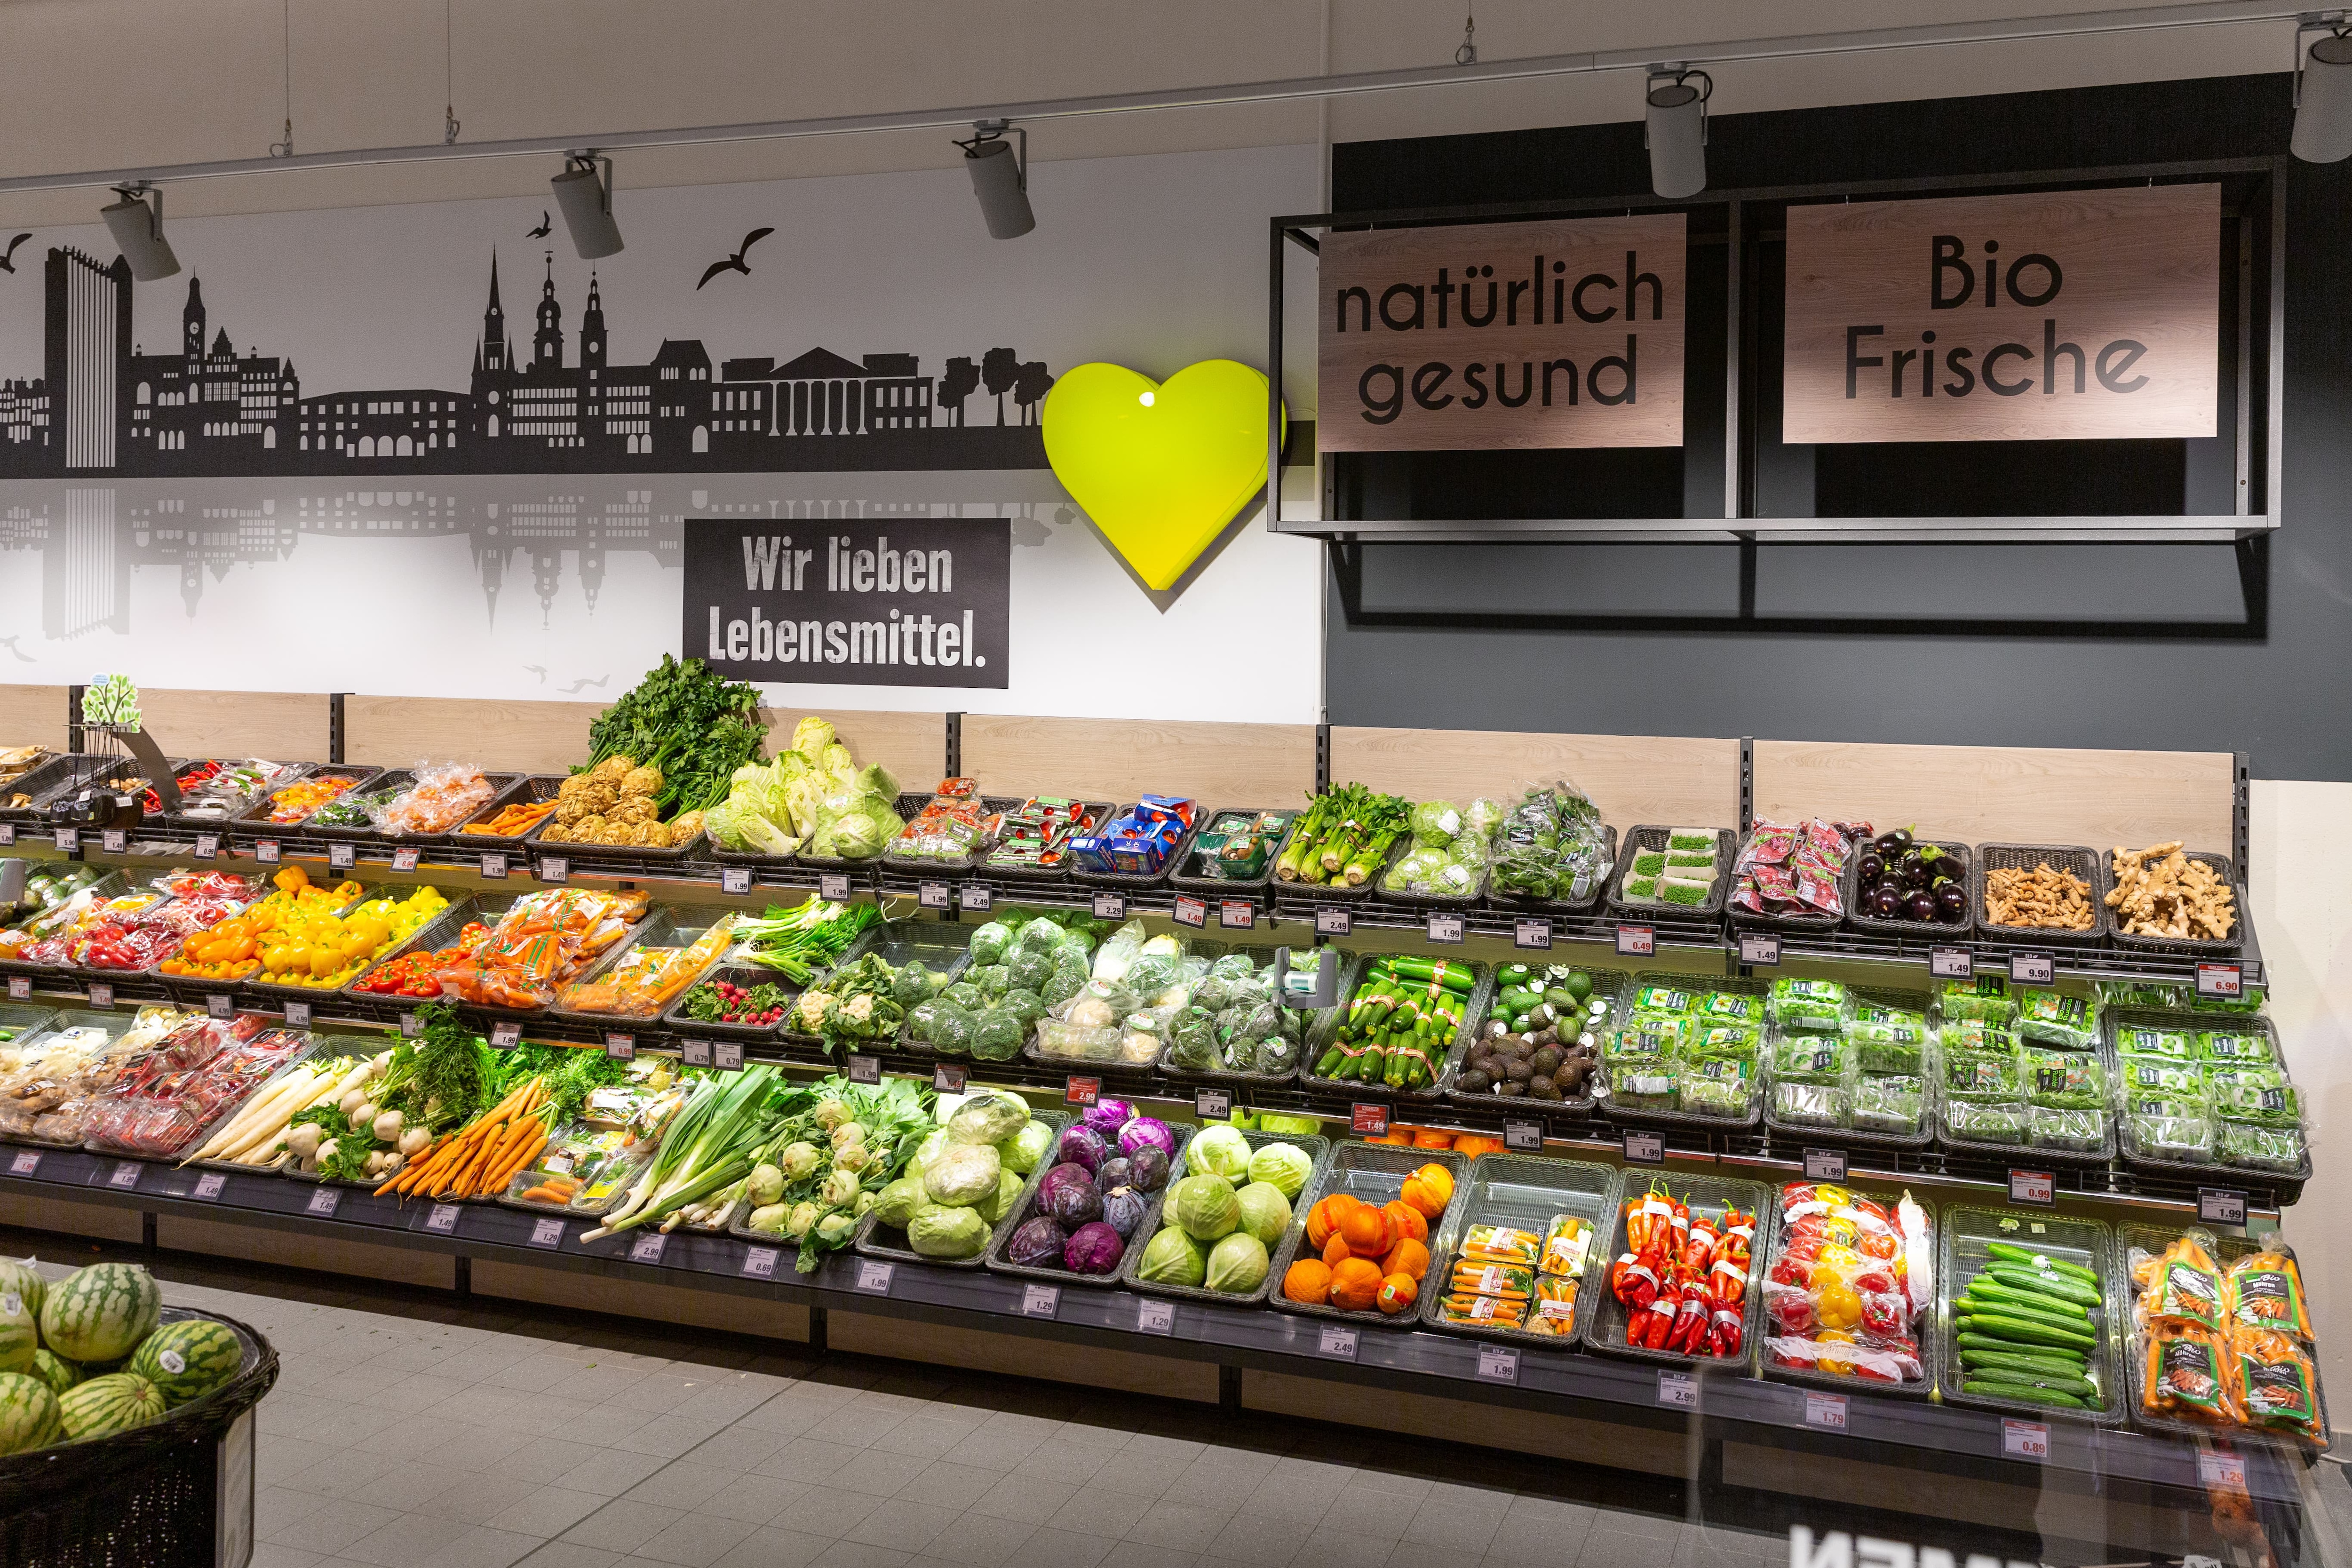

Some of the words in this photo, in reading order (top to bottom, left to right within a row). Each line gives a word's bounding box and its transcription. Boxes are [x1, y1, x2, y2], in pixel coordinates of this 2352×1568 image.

[1931, 235, 2062, 310] Bio
[1337, 251, 1662, 332] natürlich
[1846, 319, 2150, 399] Frische
[1359, 334, 1637, 425] gesund
[742, 536, 812, 591] Wir
[828, 536, 952, 593] lieben
[709, 606, 986, 668] Lebensmittel.
[1187, 913, 1202, 922] 1.49
[1633, 941, 1651, 950] 0.49
[1757, 950, 1775, 959] 1.49
[1948, 963, 1968, 972] 1.49
[2029, 969, 2049, 978] 9.90
[2216, 981, 2237, 990] 6.90
[2063, 998, 2073, 1020] Rucola
[947, 1079, 961, 1088] 1.49
[1080, 1092, 1095, 1100] 2.99
[1210, 1105, 1226, 1114] 2.49
[1367, 1121, 1384, 1130] 1.49
[1521, 1136, 1538, 1144] 1.99
[1641, 1148, 1660, 1157] 1.99
[1823, 1167, 1842, 1176] 1.99
[2028, 1188, 2050, 1198] 0.99
[2219, 1209, 2241, 1218] 1.99
[543, 1233, 557, 1242] 1.29
[644, 1247, 659, 1256] 2.99
[2190, 1271, 2208, 1282] Bio
[1036, 1301, 1052, 1310] 1.29
[1152, 1317, 1168, 1326] 1.29
[1334, 1342, 1352, 1352] 2.49
[2182, 1344, 2201, 1355] Bio
[2175, 1350, 2196, 1359] Möhren
[1494, 1365, 1512, 1375] 1.99
[1676, 1392, 1695, 1402] 2.99
[1823, 1412, 1843, 1423] 1.79
[2023, 1441, 2045, 1453] 0.89
[2220, 1471, 2243, 1483] 1.29
